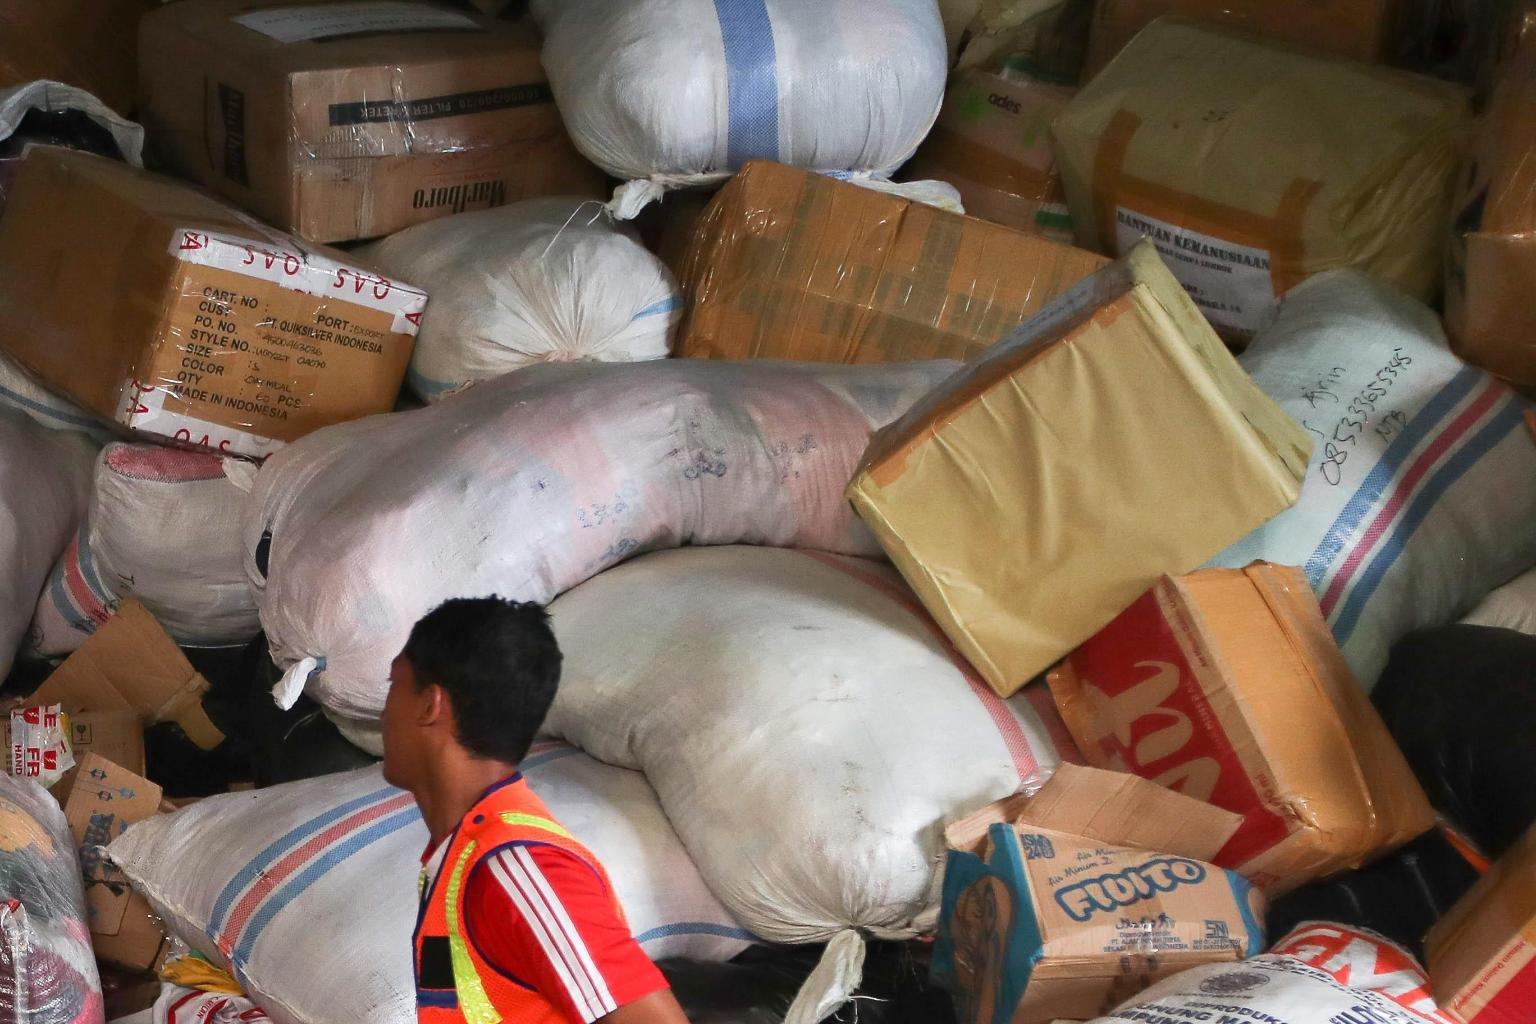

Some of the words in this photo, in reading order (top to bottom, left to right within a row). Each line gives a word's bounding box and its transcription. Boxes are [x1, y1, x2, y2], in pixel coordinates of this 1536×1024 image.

[987, 93, 1022, 114] ades
[240, 296, 259, 309] NO
[194, 315, 215, 329] PO.
[316, 315, 350, 331] PORT
[190, 329, 228, 348] STYLE
[334, 334, 384, 354] INDONESIA
[186, 343, 212, 358] SIZE
[181, 357, 225, 376] COLOR
[177, 371, 202, 385] QTY
[173, 385, 209, 404] MADE
[211, 393, 224, 406] IN
[225, 397, 289, 420] INDONESIA
[15, 744, 24, 776] HAND
[1064, 861, 1100, 878] Minum
